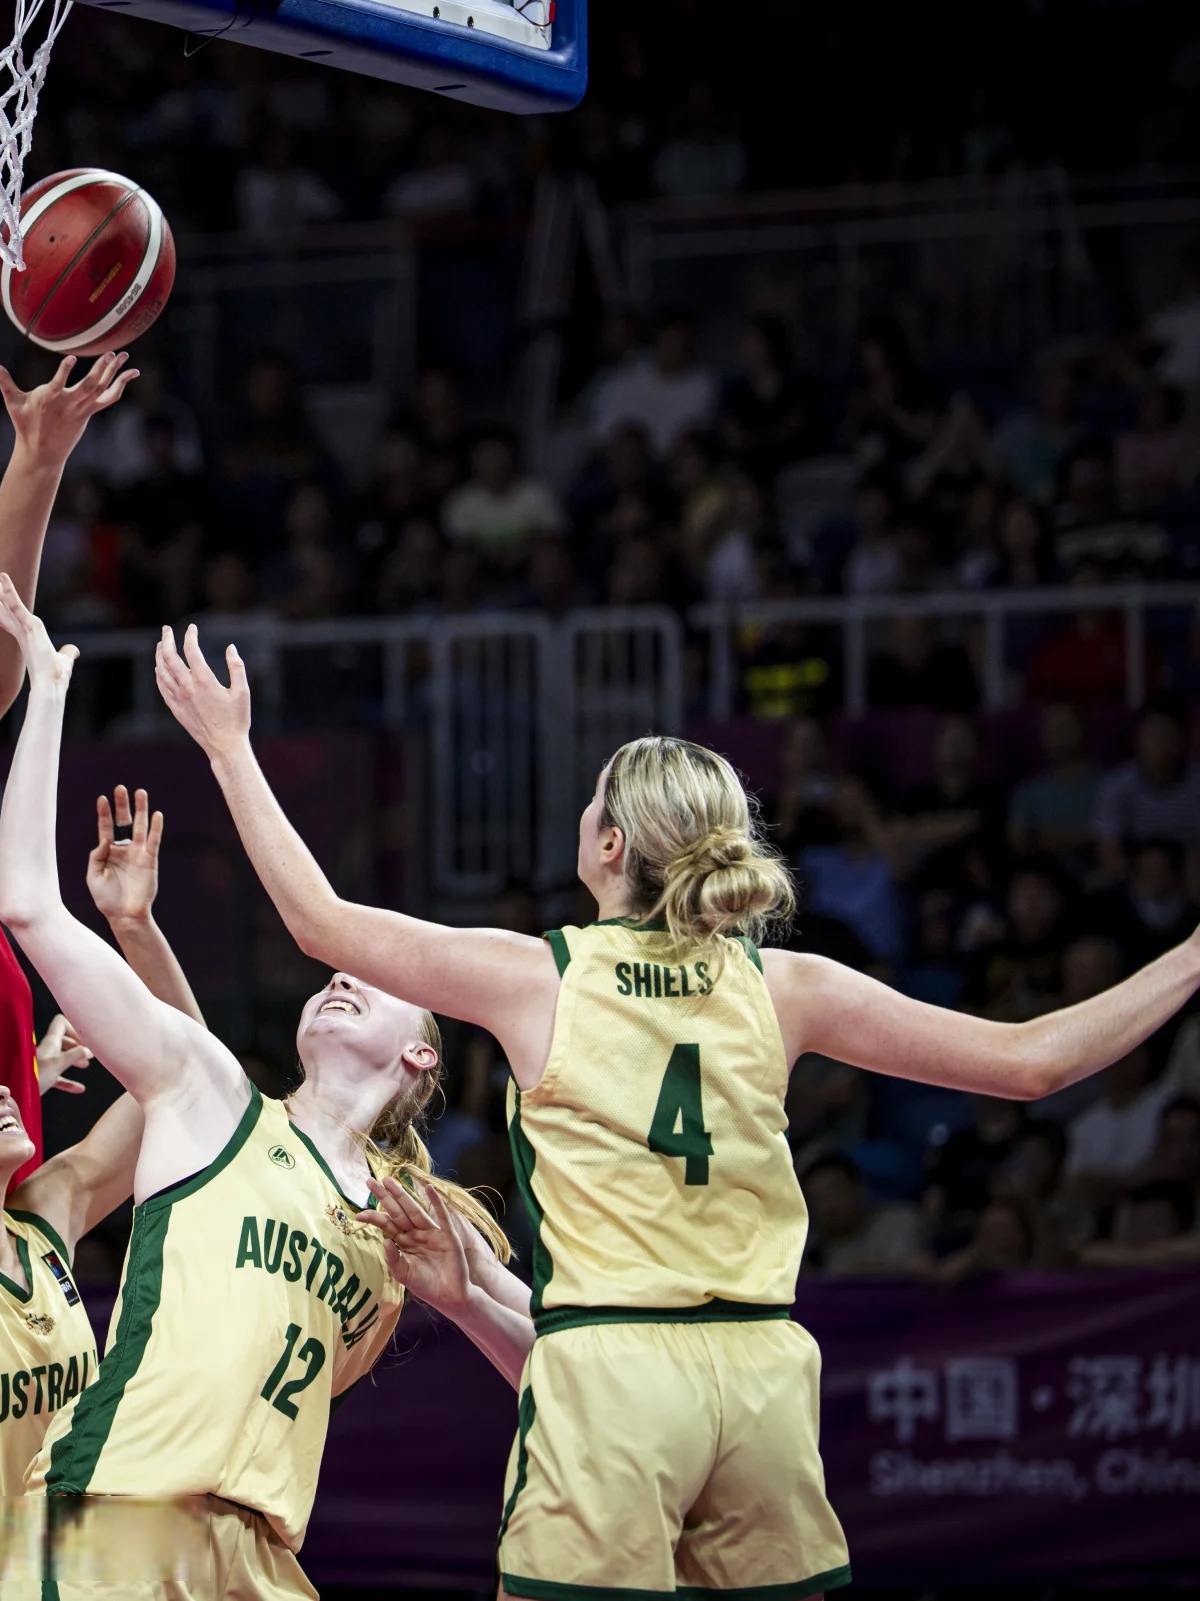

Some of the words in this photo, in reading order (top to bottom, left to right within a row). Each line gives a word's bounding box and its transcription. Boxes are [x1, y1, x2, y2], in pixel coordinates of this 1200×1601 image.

[615, 961, 714, 998] SHIELS
[648, 1043, 714, 1186] 4
[260, 1322, 326, 1422] 12
